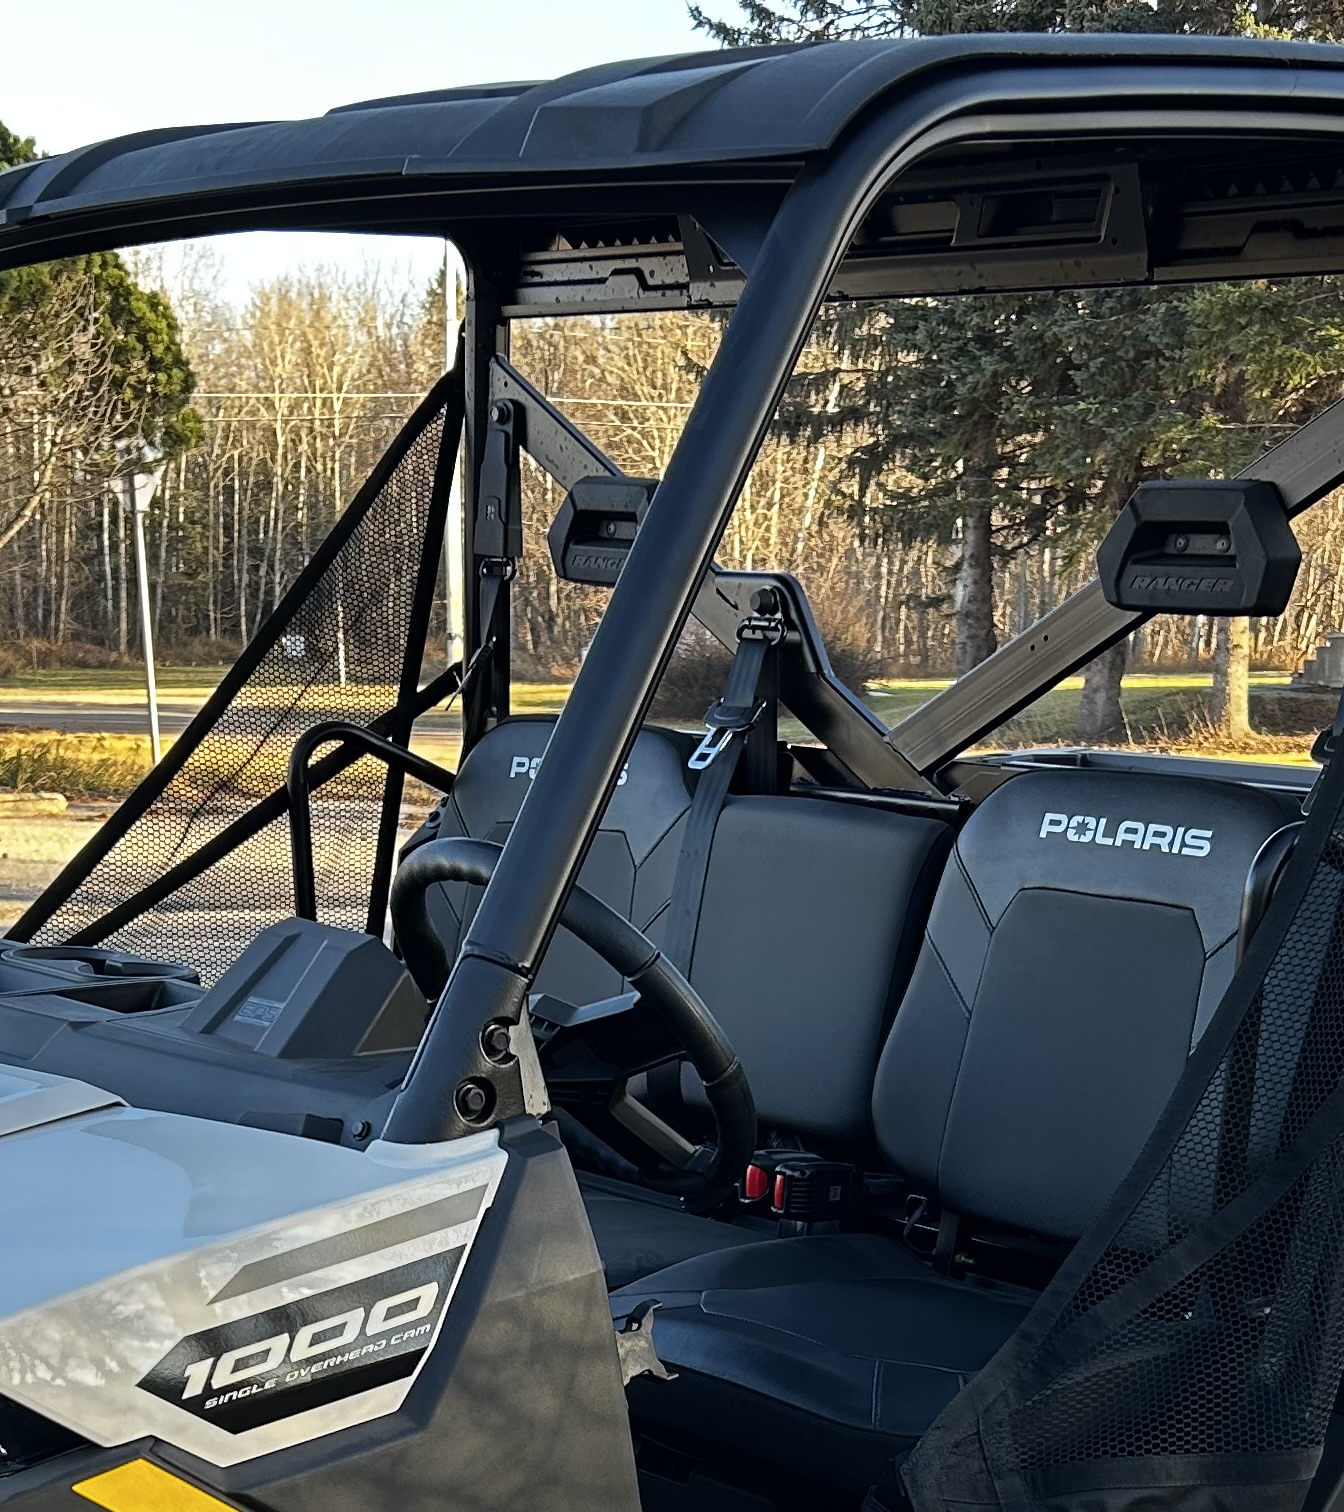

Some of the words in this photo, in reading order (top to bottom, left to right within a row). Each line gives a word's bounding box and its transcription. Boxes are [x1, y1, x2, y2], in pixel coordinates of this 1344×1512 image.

[571, 554, 626, 569] RANG
[1129, 575, 1235, 592] RANGER
[1039, 812, 1213, 857] POLARIS
[182, 1281, 439, 1400] 1000
[204, 1377, 279, 1410] SINGLE
[285, 1340, 387, 1382] OVERHEAD
[390, 1323, 432, 1346] CAM
